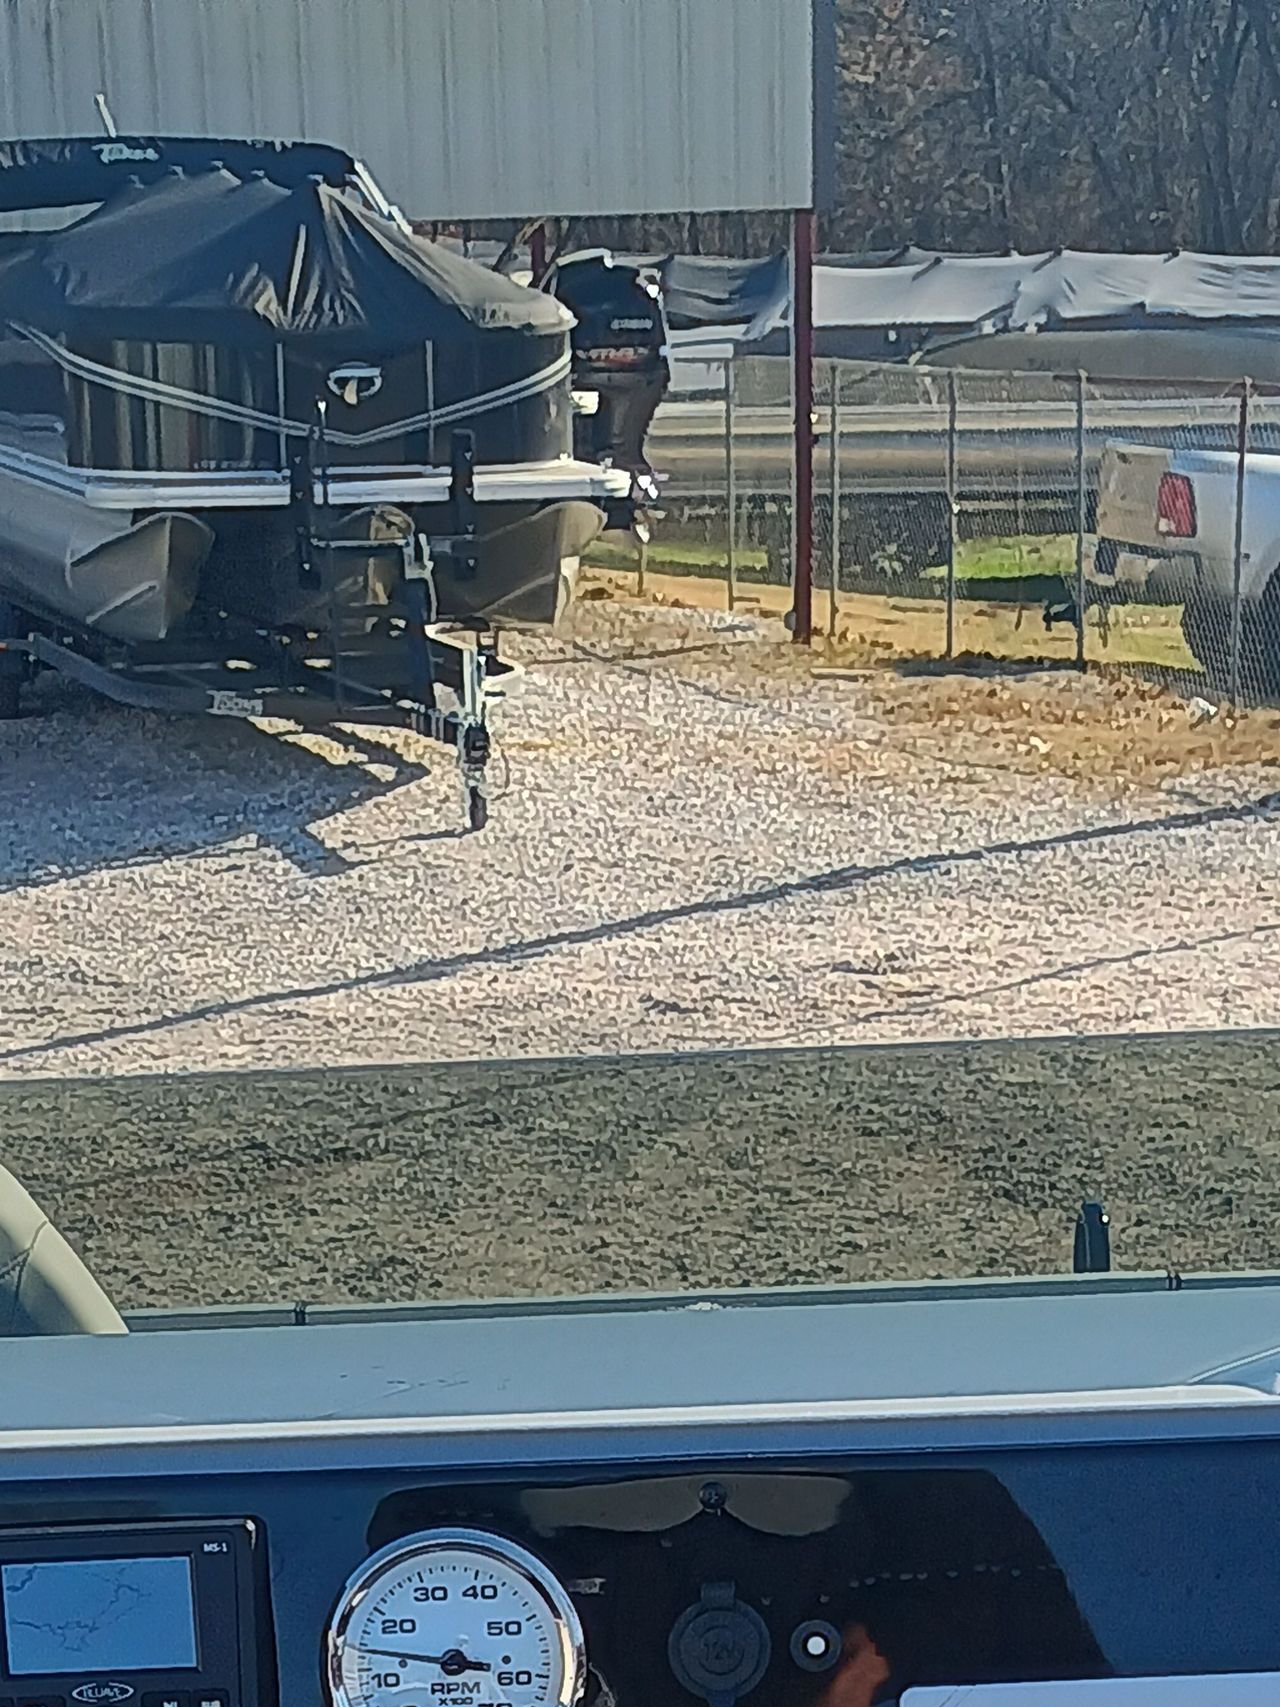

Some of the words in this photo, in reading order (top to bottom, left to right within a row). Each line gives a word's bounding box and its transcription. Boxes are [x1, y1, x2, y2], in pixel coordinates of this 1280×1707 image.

[413, 1586, 448, 1601] 30
[462, 1585, 498, 1600] 40
[381, 1619, 416, 1634] 20
[487, 1621, 522, 1636] 50
[371, 1673, 401, 1688] 10
[497, 1671, 532, 1686] 60
[430, 1681, 481, 1695] RPM
